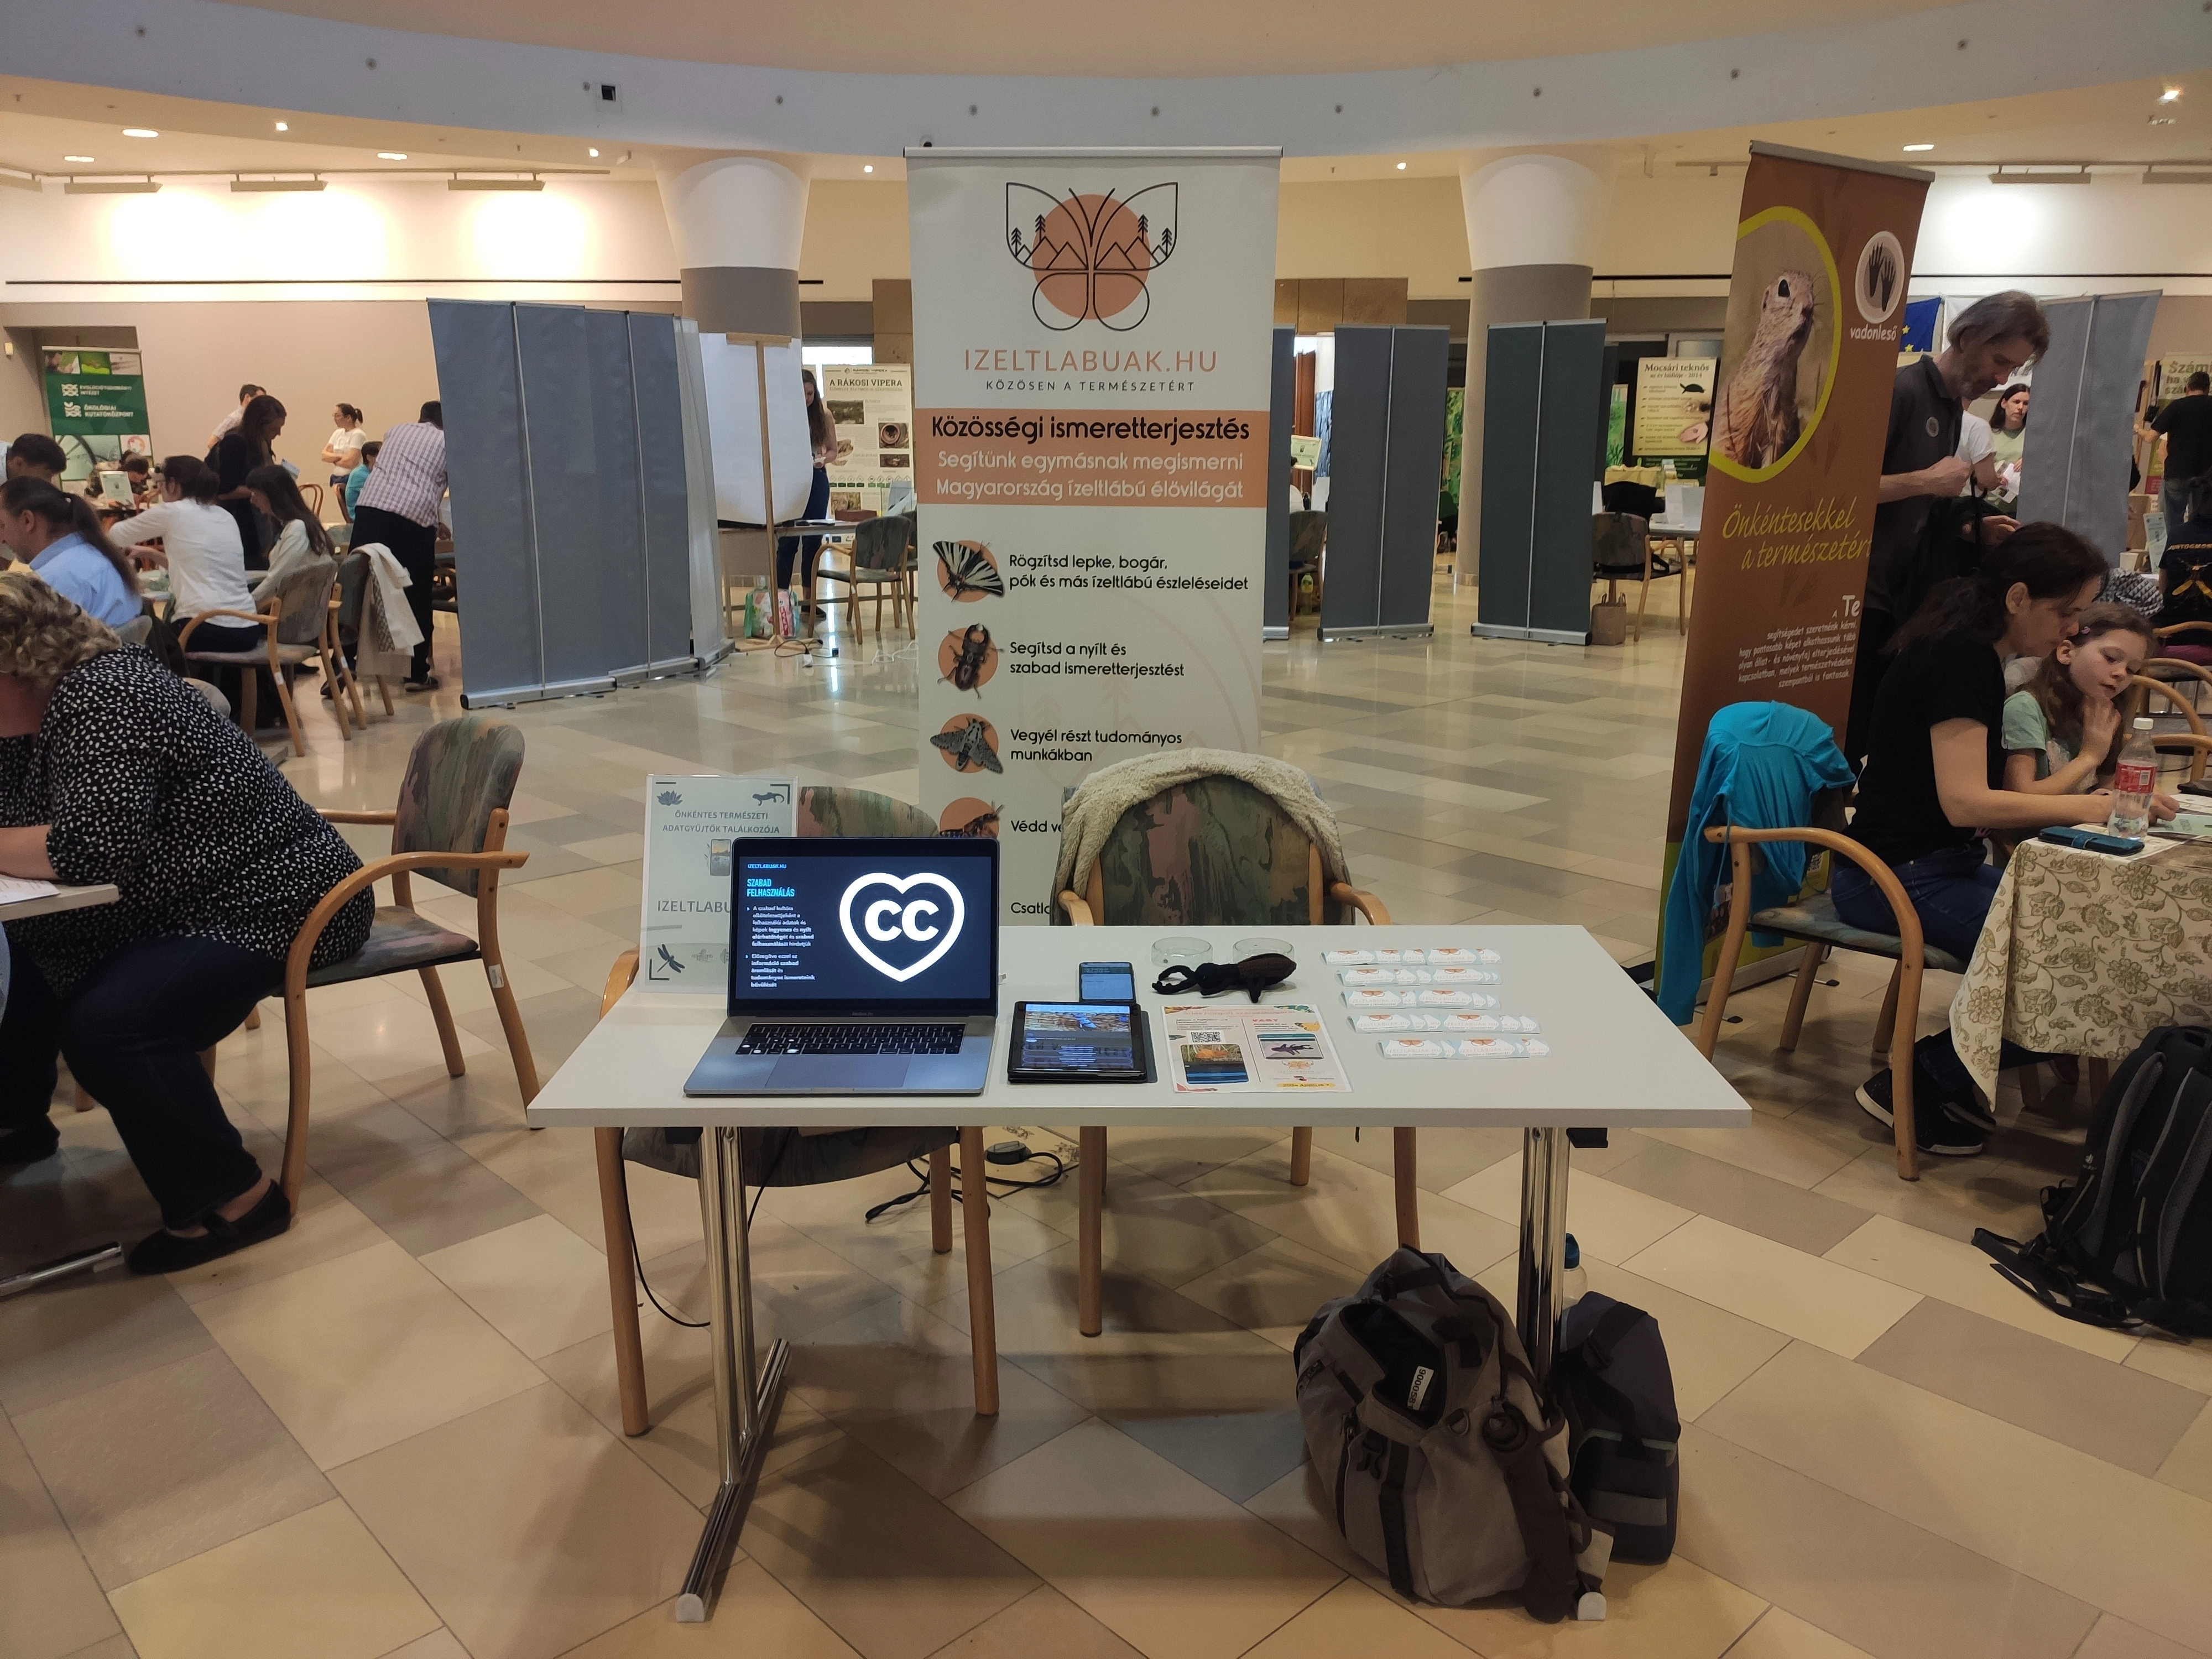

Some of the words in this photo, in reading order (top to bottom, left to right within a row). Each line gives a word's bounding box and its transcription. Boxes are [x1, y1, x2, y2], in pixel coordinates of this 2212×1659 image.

[1850, 324, 1898, 341] vadonleső
[964, 349, 1218, 373] IZELTLABUAK.HU
[2169, 361, 2212, 373] Szám
[985, 379, 1056, 392] KÖZÖSEN
[1063, 382, 1071, 392] A
[1079, 380, 1194, 392] TERMÉSZETÉRT
[932, 415, 1043, 445] Közösségi
[1050, 416, 1250, 445] ismeretterjesztés
[938, 450, 1016, 472] Segítünk
[1021, 452, 1128, 473] egymásnak
[1133, 453, 1243, 474] megismerni
[936, 478, 1063, 500] Magyarország
[1068, 480, 1146, 498] ízeltlábú
[1151, 481, 1243, 502] élővilágát
[1723, 496, 1857, 539] Önkéntesekkel
[1010, 554, 1068, 572] Rögzítsd
[1072, 555, 1115, 572] lepke,
[1119, 556, 1167, 573] bogár,
[1741, 549, 1755, 570] a
[1010, 574, 1036, 591] pók
[1040, 575, 1055, 589] és
[1059, 575, 1088, 589] más
[1091, 576, 1152, 589] ízeltlábú
[1156, 576, 1248, 591] észleléseidet
[1843, 595, 1860, 618] Te
[1010, 641, 1062, 659] Segítsd
[1066, 646, 1075, 655] a
[1079, 642, 1107, 659] nyílt
[1111, 643, 1126, 655] és
[1010, 661, 1061, 675] szabad
[1065, 661, 1185, 679] ismeretterjesztést
[1011, 728, 1057, 745] Vegyél
[1061, 729, 1092, 743] részt
[1095, 731, 1182, 747] tudományos
[1011, 748, 1093, 763] munkákban
[719, 811, 768, 820] TERMÉSZETI
[723, 825, 779, 833] TALÁLKOZÓJA
[1011, 818, 1048, 832] Védd
[747, 887, 795, 896] FELHASZNÁLÁS
